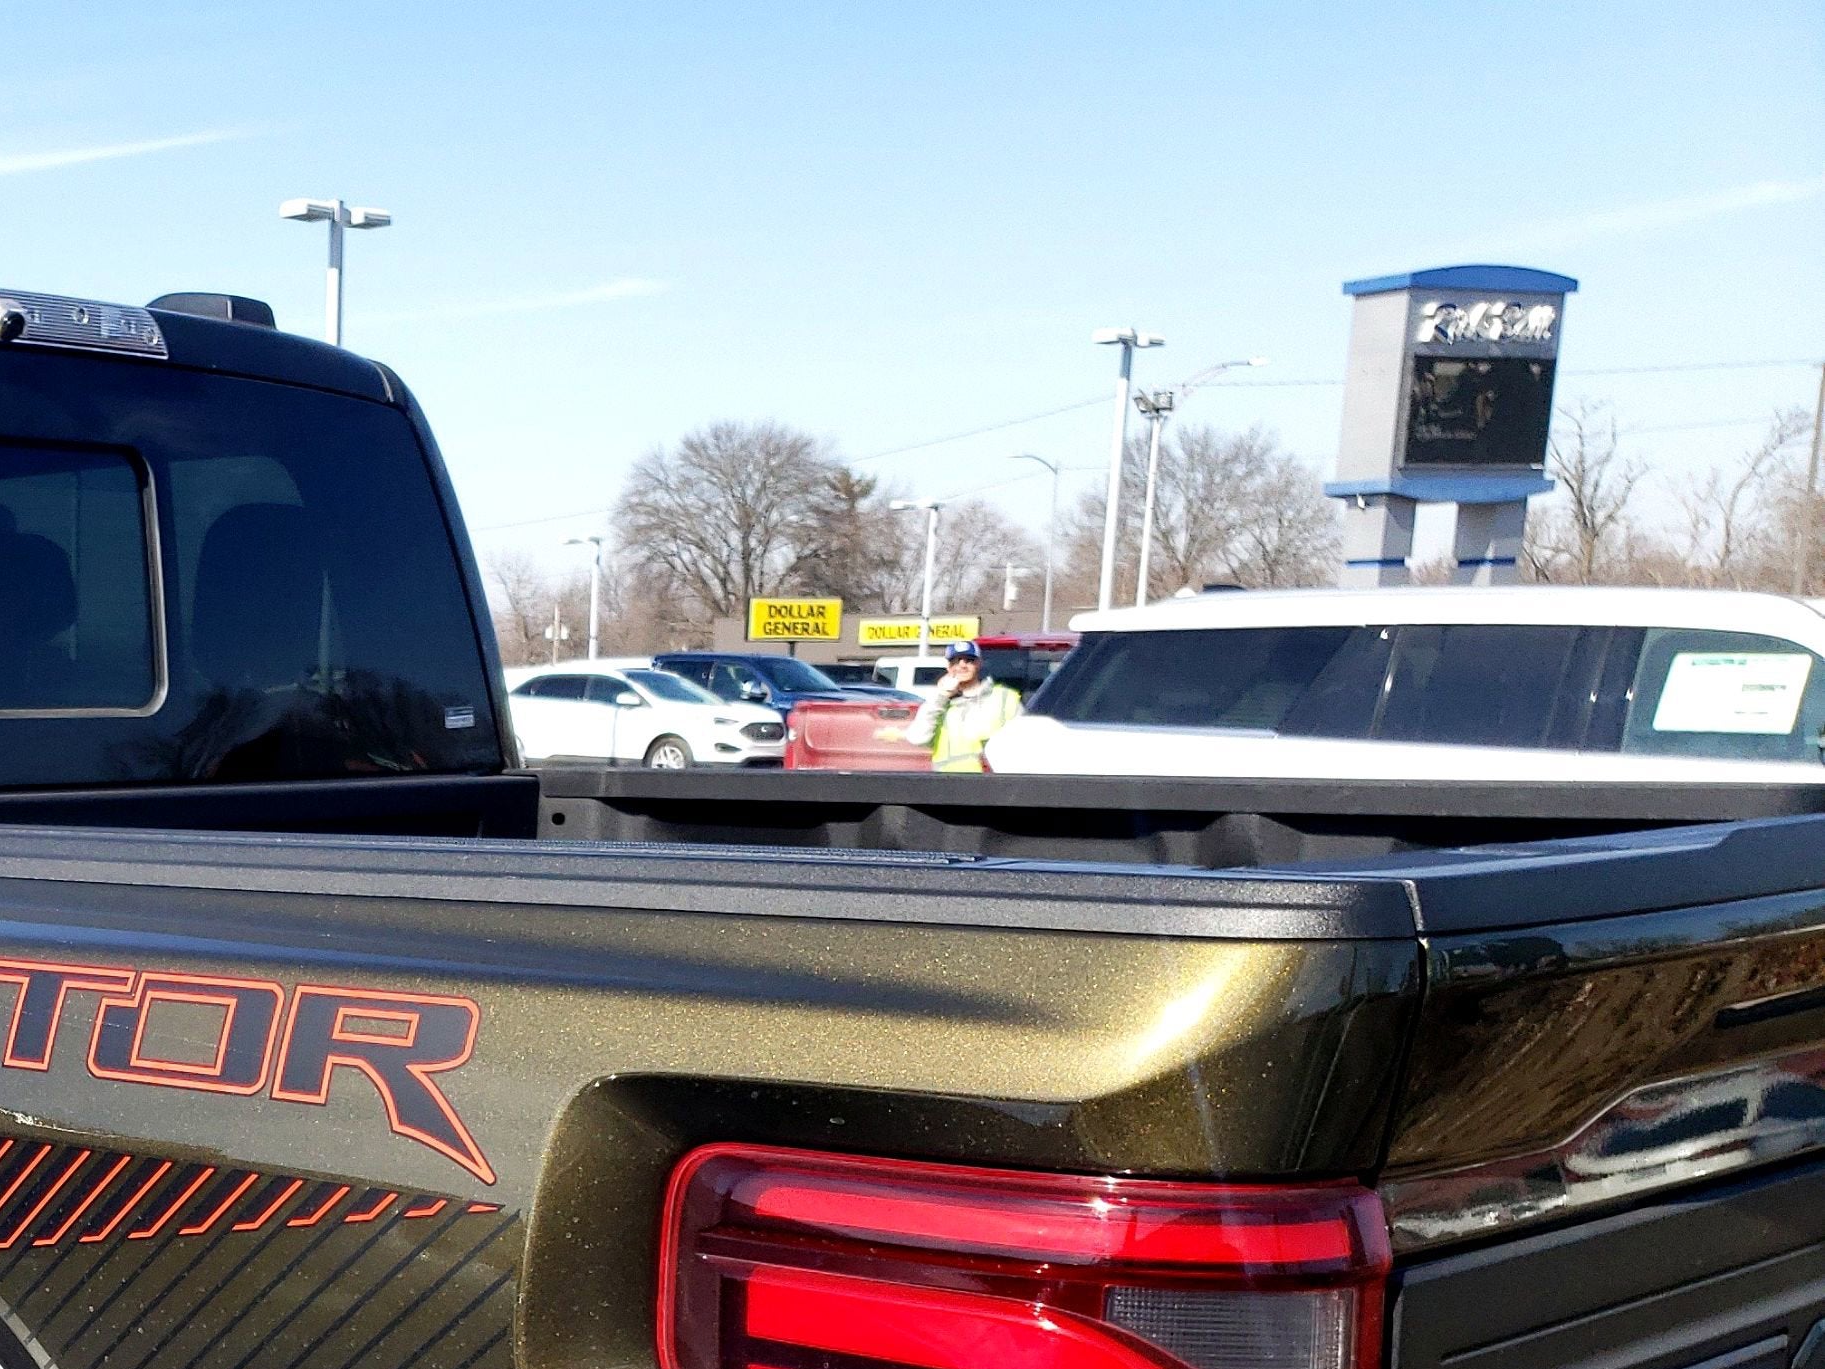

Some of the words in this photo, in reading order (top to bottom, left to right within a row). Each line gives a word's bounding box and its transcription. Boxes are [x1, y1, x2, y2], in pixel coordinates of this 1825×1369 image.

[767, 604, 827, 620] DOLLAR
[762, 621, 830, 637] GENERAL
[867, 625, 911, 641] DOLLAR
[915, 623, 966, 639] GNERAL
